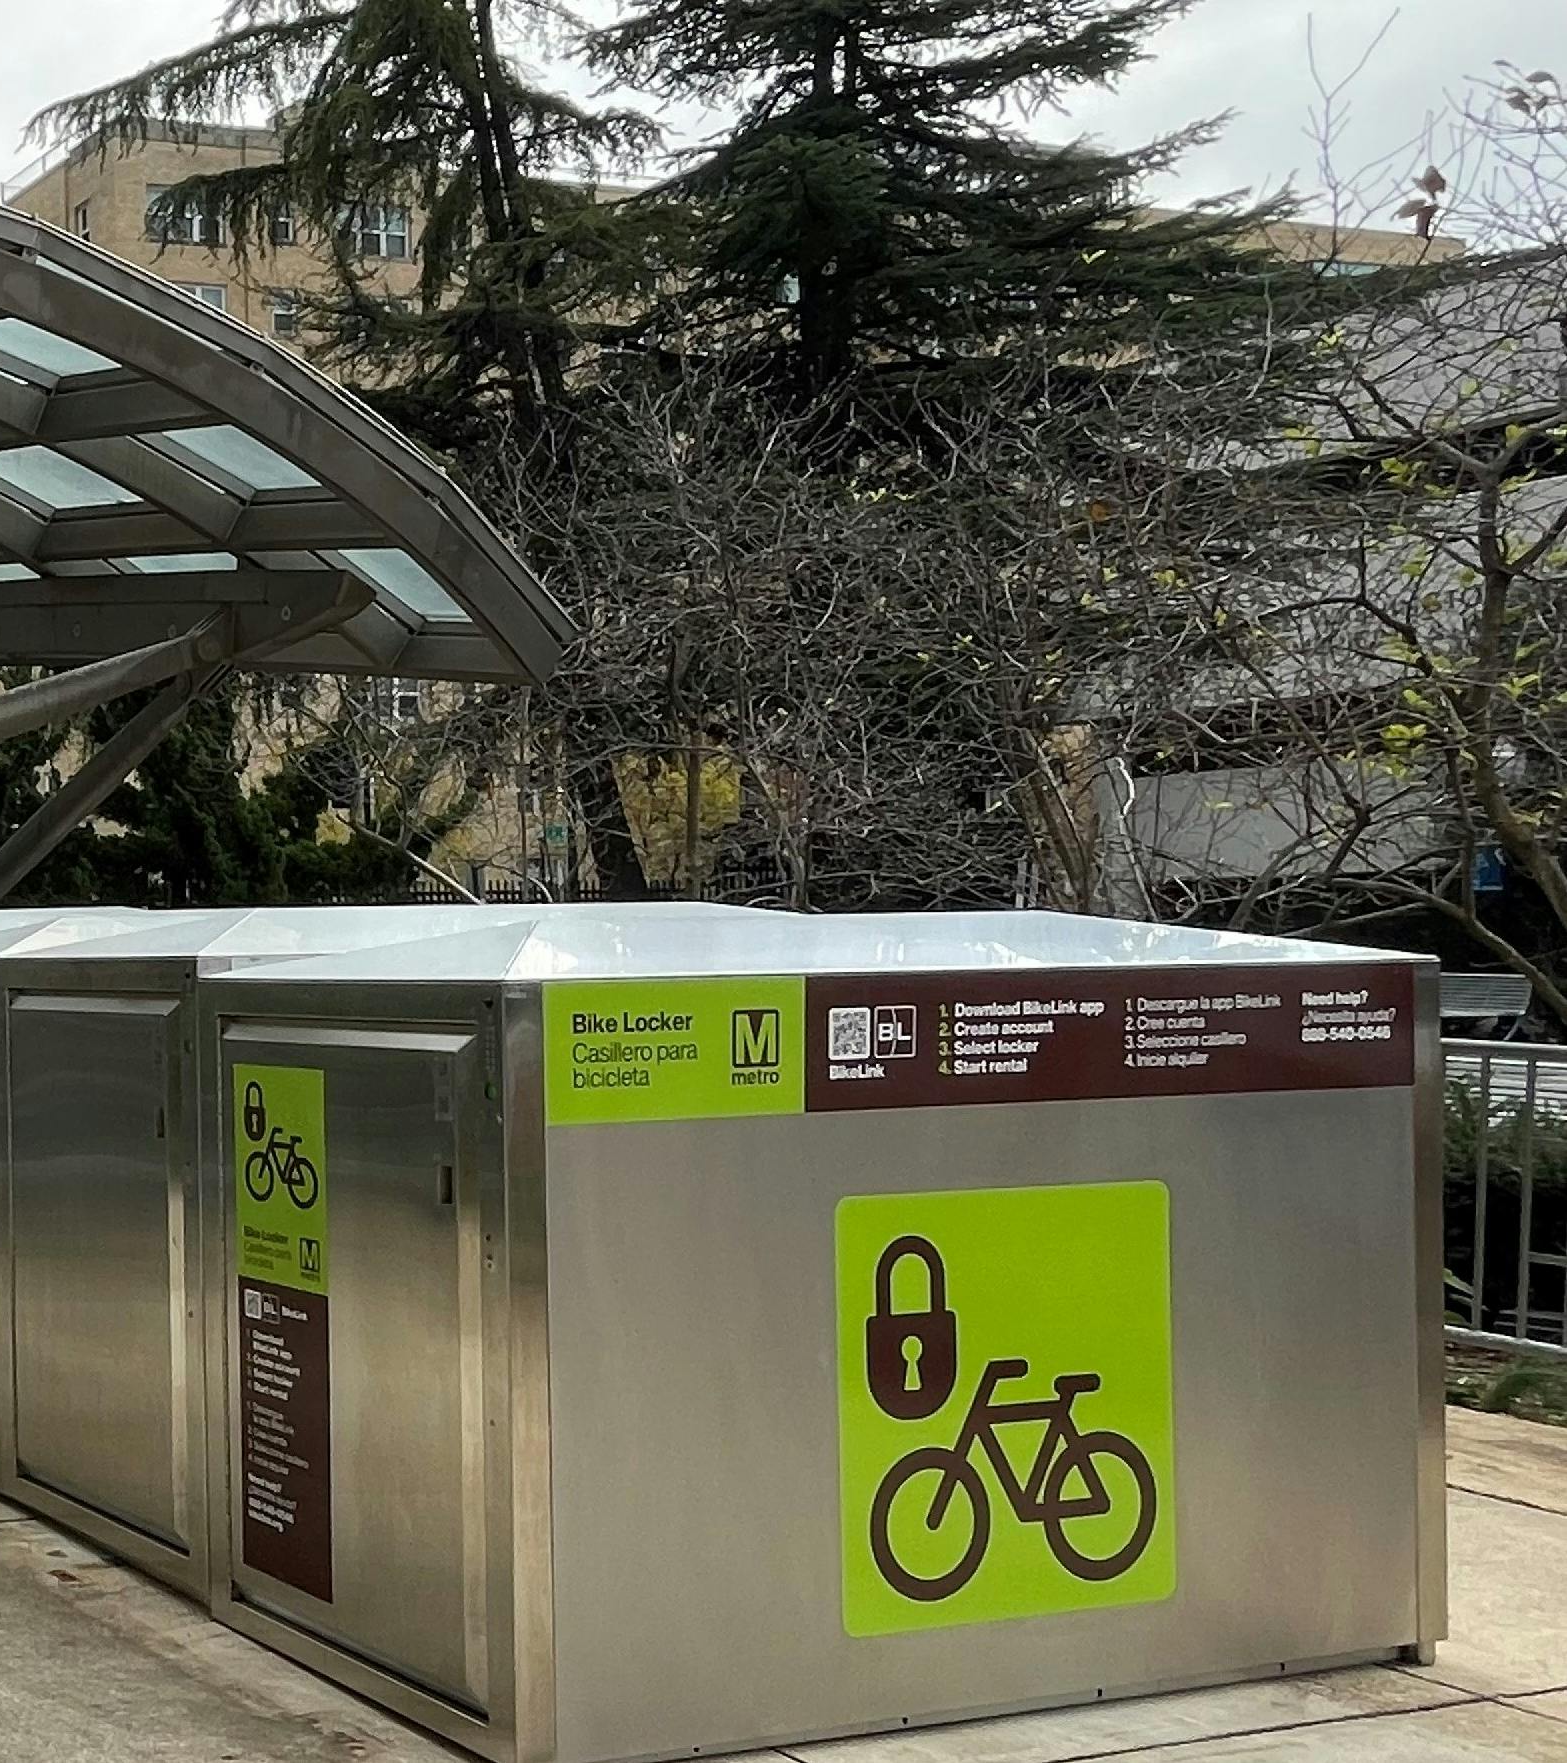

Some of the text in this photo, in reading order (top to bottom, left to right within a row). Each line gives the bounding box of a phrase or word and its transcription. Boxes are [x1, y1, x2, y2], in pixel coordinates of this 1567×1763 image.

[954, 1001, 1021, 1018] Download
[1023, 1000, 1077, 1017] BikeLink
[1079, 1001, 1105, 1018] app
[572, 1011, 693, 1035] Bike Locker
[878, 1022, 912, 1041] BL
[953, 1021, 1000, 1037] Create
[1002, 1019, 1054, 1036] account
[735, 1012, 777, 1065] M
[953, 1041, 996, 1056] Select
[998, 1039, 1040, 1054] locker
[572, 1042, 698, 1066] Casillero para
[828, 1063, 886, 1081] BikeLink
[953, 1059, 987, 1075] Start
[989, 1057, 1028, 1073] rental
[572, 1068, 651, 1089] bicicleta
[731, 1070, 779, 1086] metro
